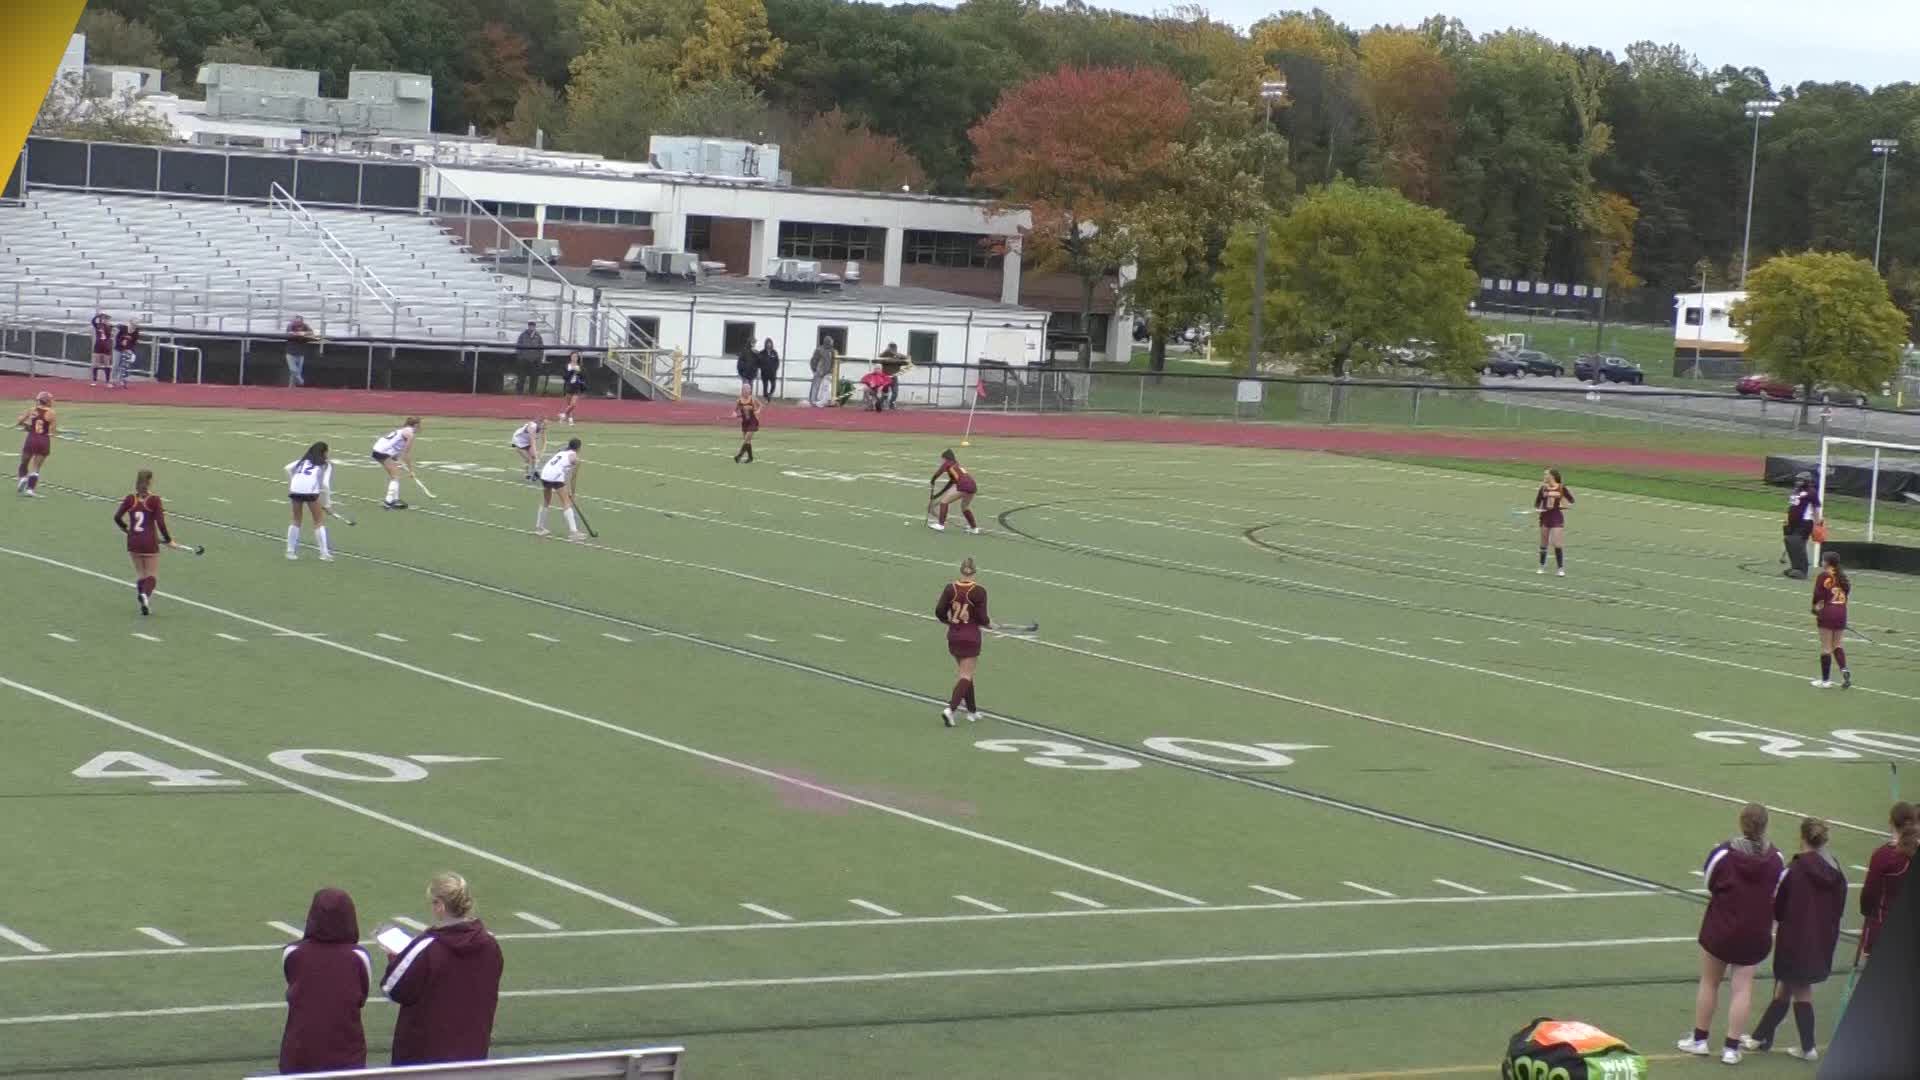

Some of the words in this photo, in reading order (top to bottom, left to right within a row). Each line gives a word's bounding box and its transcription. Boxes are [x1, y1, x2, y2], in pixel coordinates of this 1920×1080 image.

[135, 511, 145, 532] 2
[952, 601, 970, 624] 24
[974, 738, 1295, 770] 30
[72, 749, 432, 787] 40
